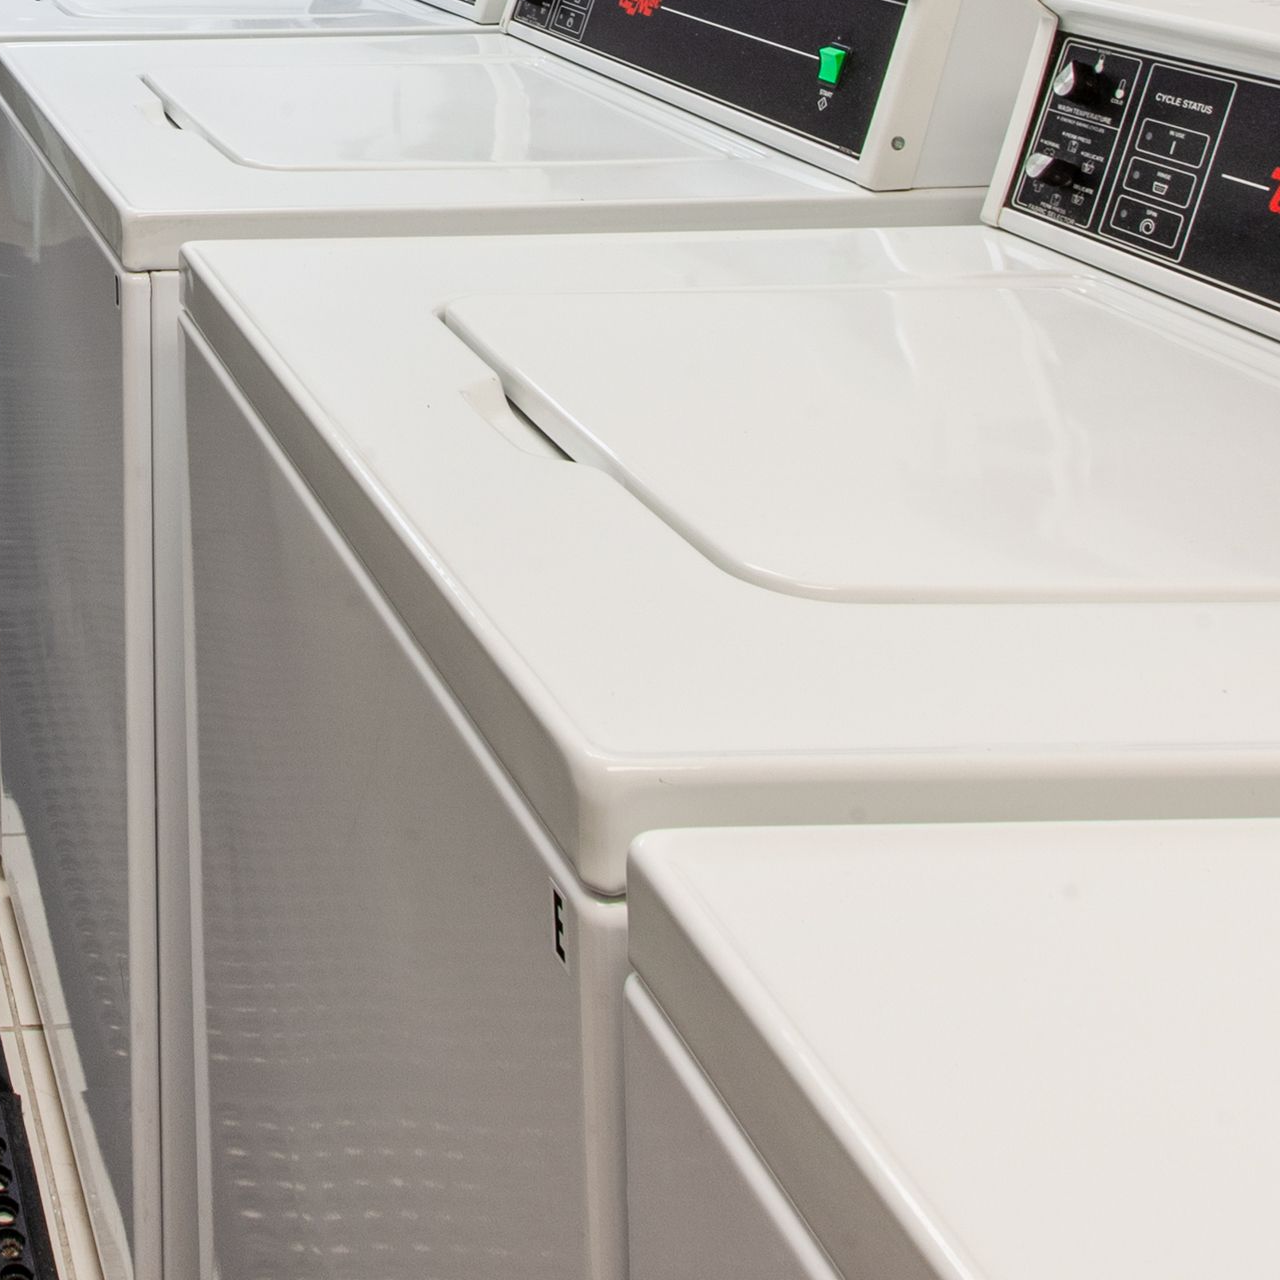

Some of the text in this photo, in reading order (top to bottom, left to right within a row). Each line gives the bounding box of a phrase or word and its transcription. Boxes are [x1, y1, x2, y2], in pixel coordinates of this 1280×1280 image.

[1155, 92, 1213, 115] CYCLE STATUS
[1073, 107, 1112, 125] TEMPERATURE
[553, 889, 566, 963] E
